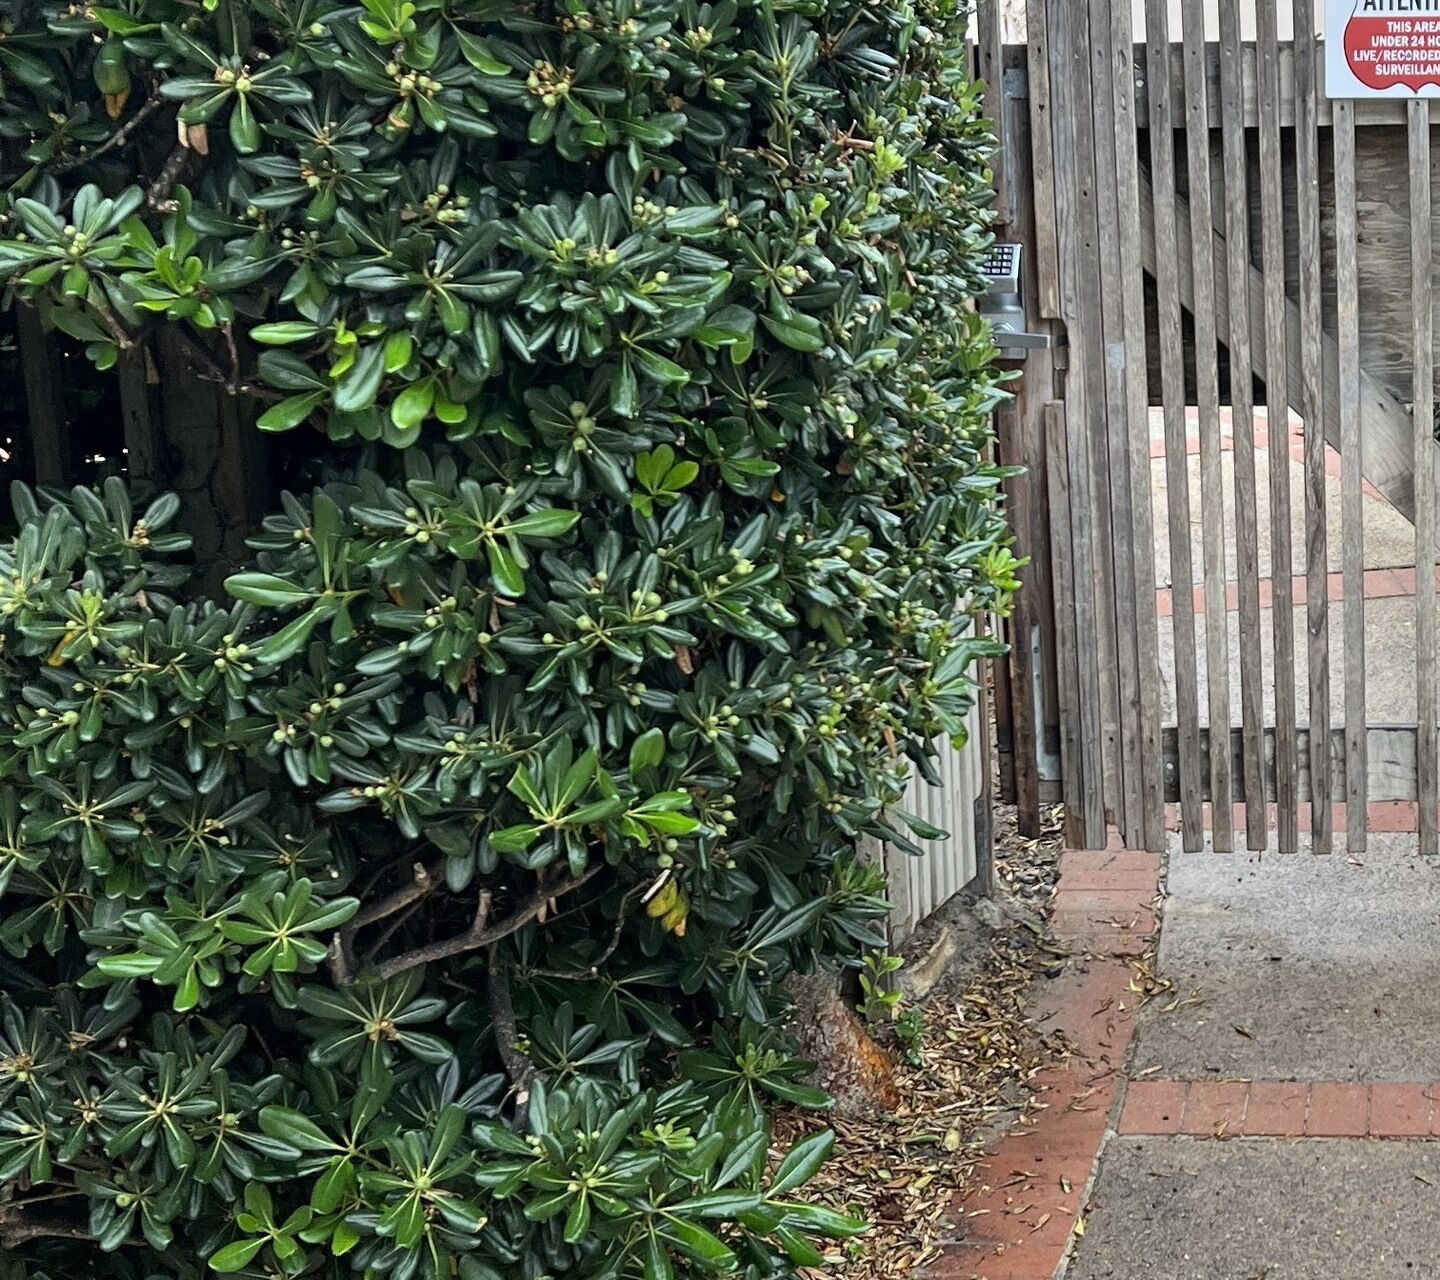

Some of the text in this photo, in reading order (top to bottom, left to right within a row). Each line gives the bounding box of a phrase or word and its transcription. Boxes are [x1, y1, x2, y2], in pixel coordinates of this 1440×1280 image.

[1387, 21, 1412, 33] THIS
[1371, 35, 1409, 47] UNDER
[1410, 35, 1425, 47] 24
